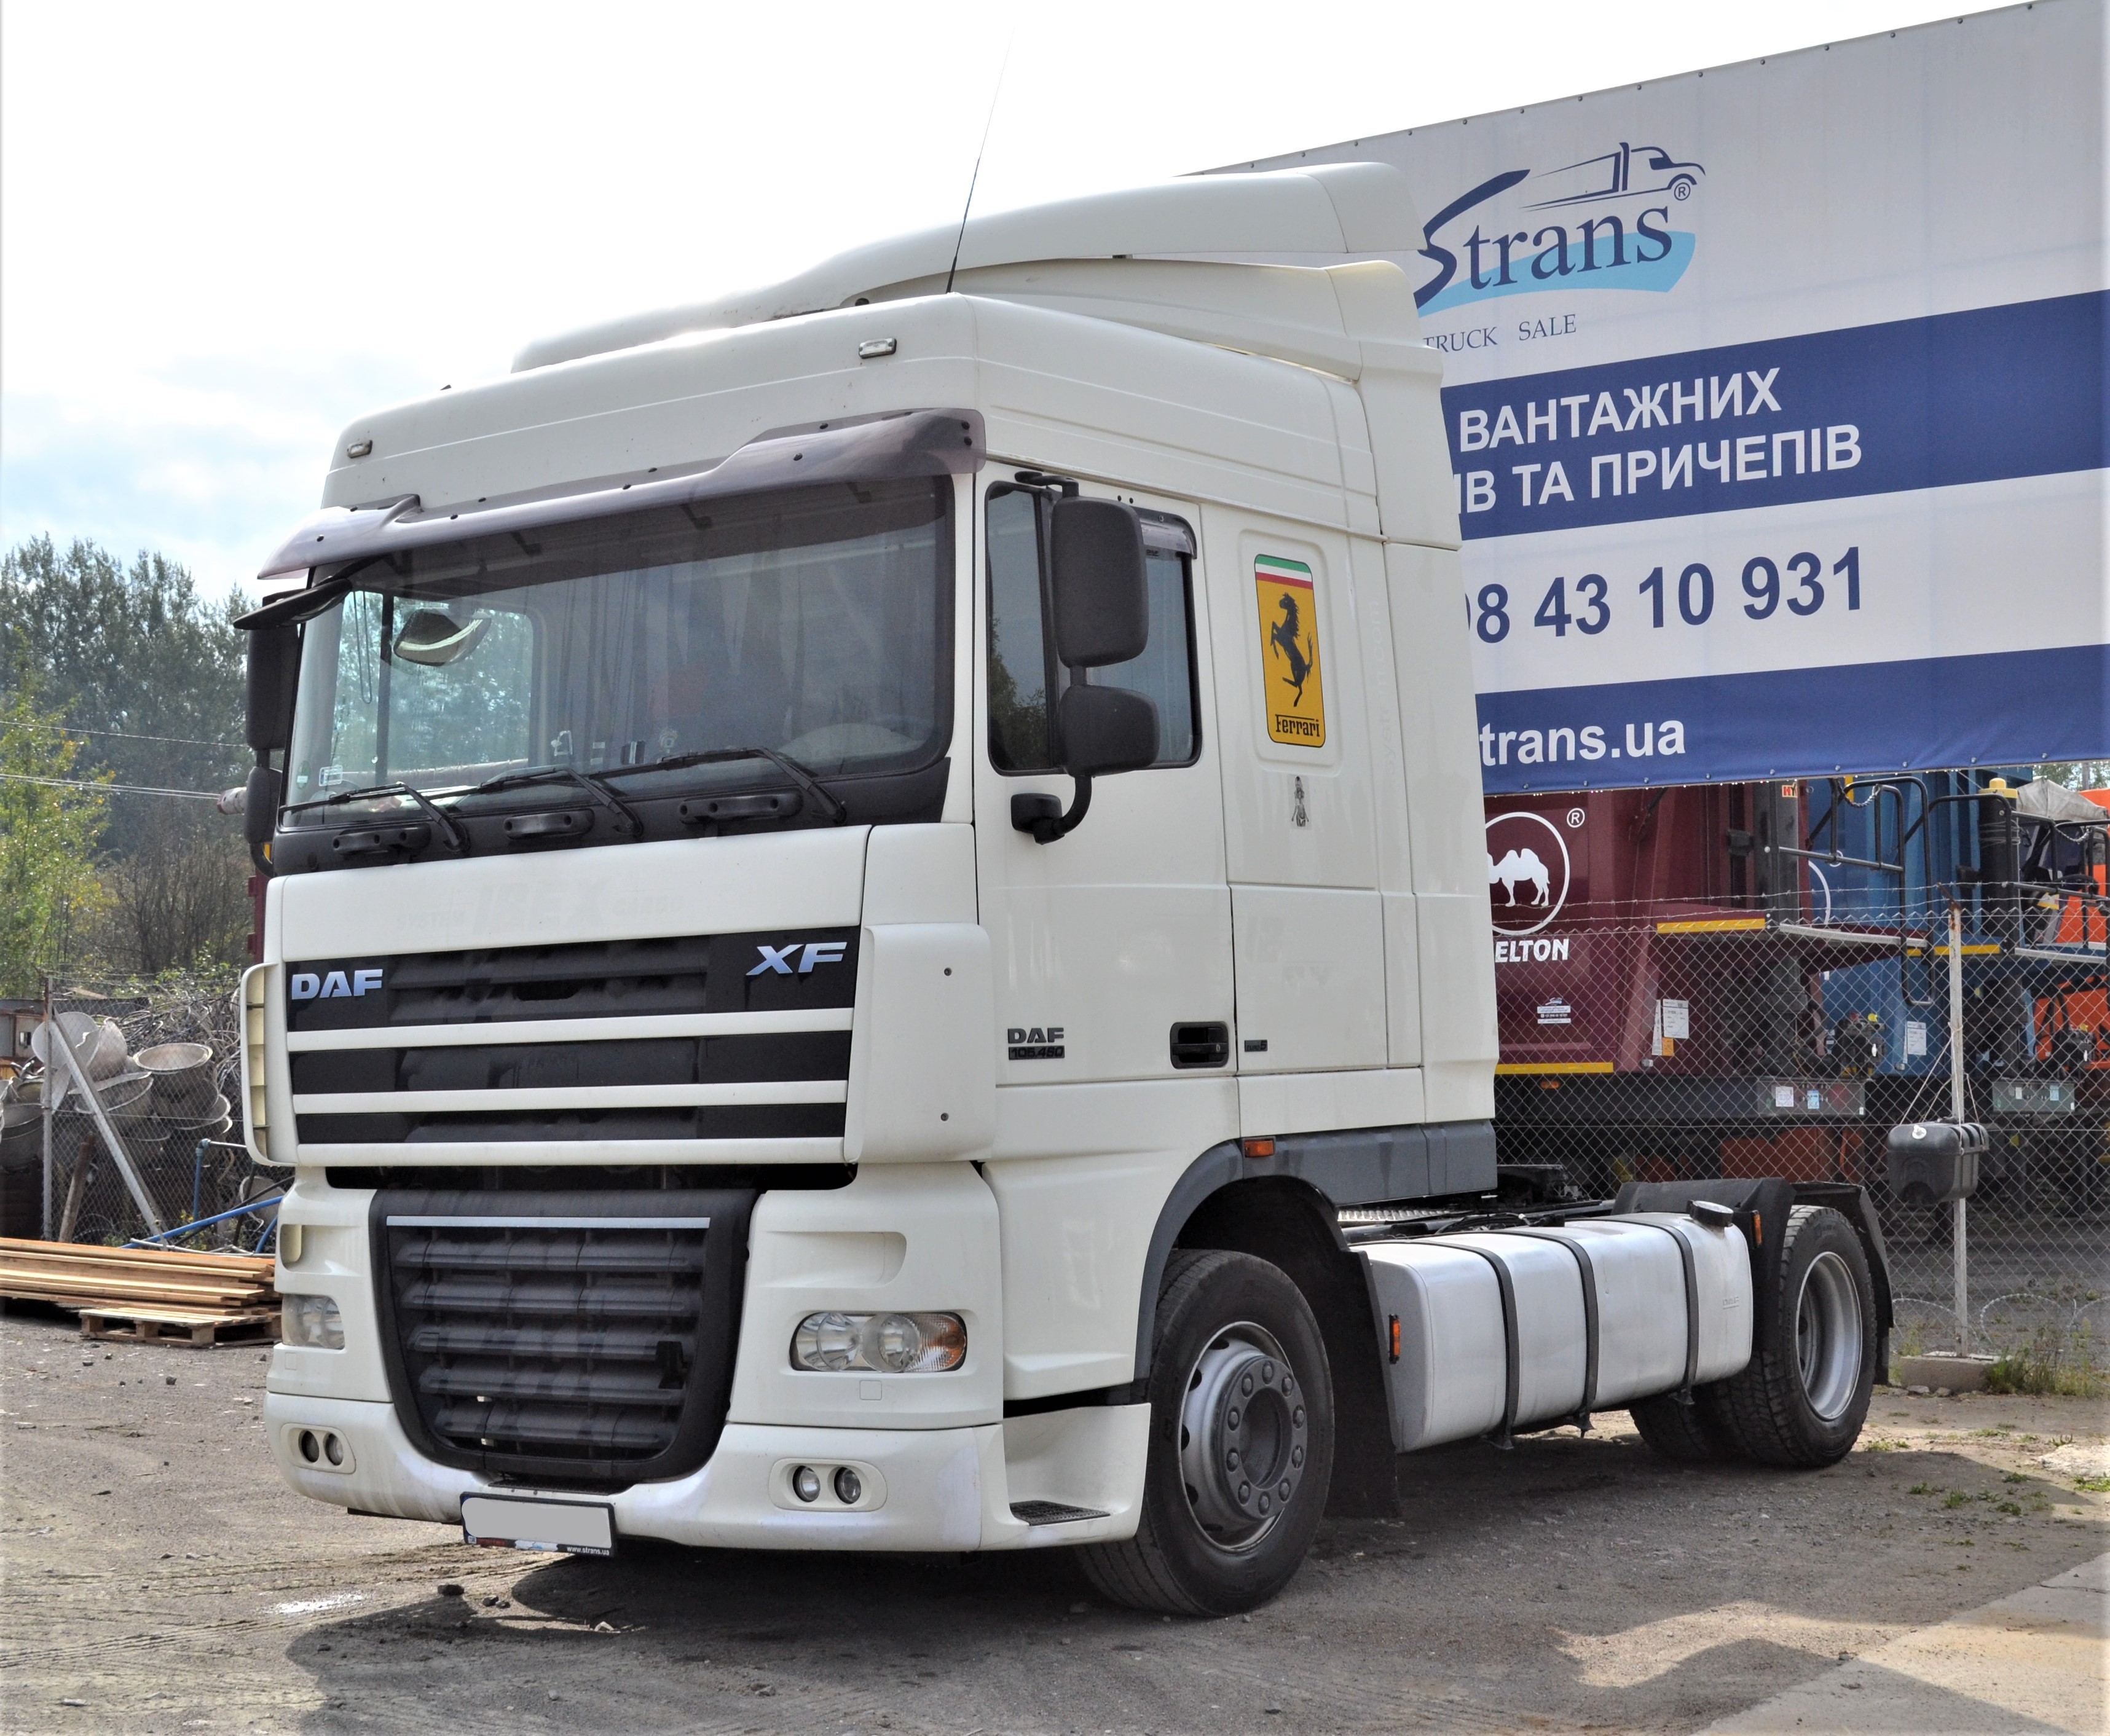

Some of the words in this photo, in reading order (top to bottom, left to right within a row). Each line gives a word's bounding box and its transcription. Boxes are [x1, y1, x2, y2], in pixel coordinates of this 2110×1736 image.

[1414, 169, 1672, 309] Strans
[1423, 326, 1498, 353] TRUCK
[1518, 313, 1577, 341] SALE
[1459, 367, 1782, 452] ВАНТАЖНИХ
[1513, 461, 1575, 507] ТА
[1591, 424, 1862, 498] ПРИЧЕПІВ
[1464, 583, 1510, 644] 8
[1533, 574, 1611, 637] 43
[1639, 563, 1715, 629] 10
[1741, 546, 1862, 621] 931
[1275, 713, 1320, 737] Ferrari
[1479, 720, 1686, 767] trans.ua
[745, 941, 848, 976] XF
[1495, 938, 1569, 963] ELTON
[291, 968, 383, 1000] DAF
[1007, 1027, 1065, 1043] DAF
[566, 1546, 610, 1556] www.strans.ua
